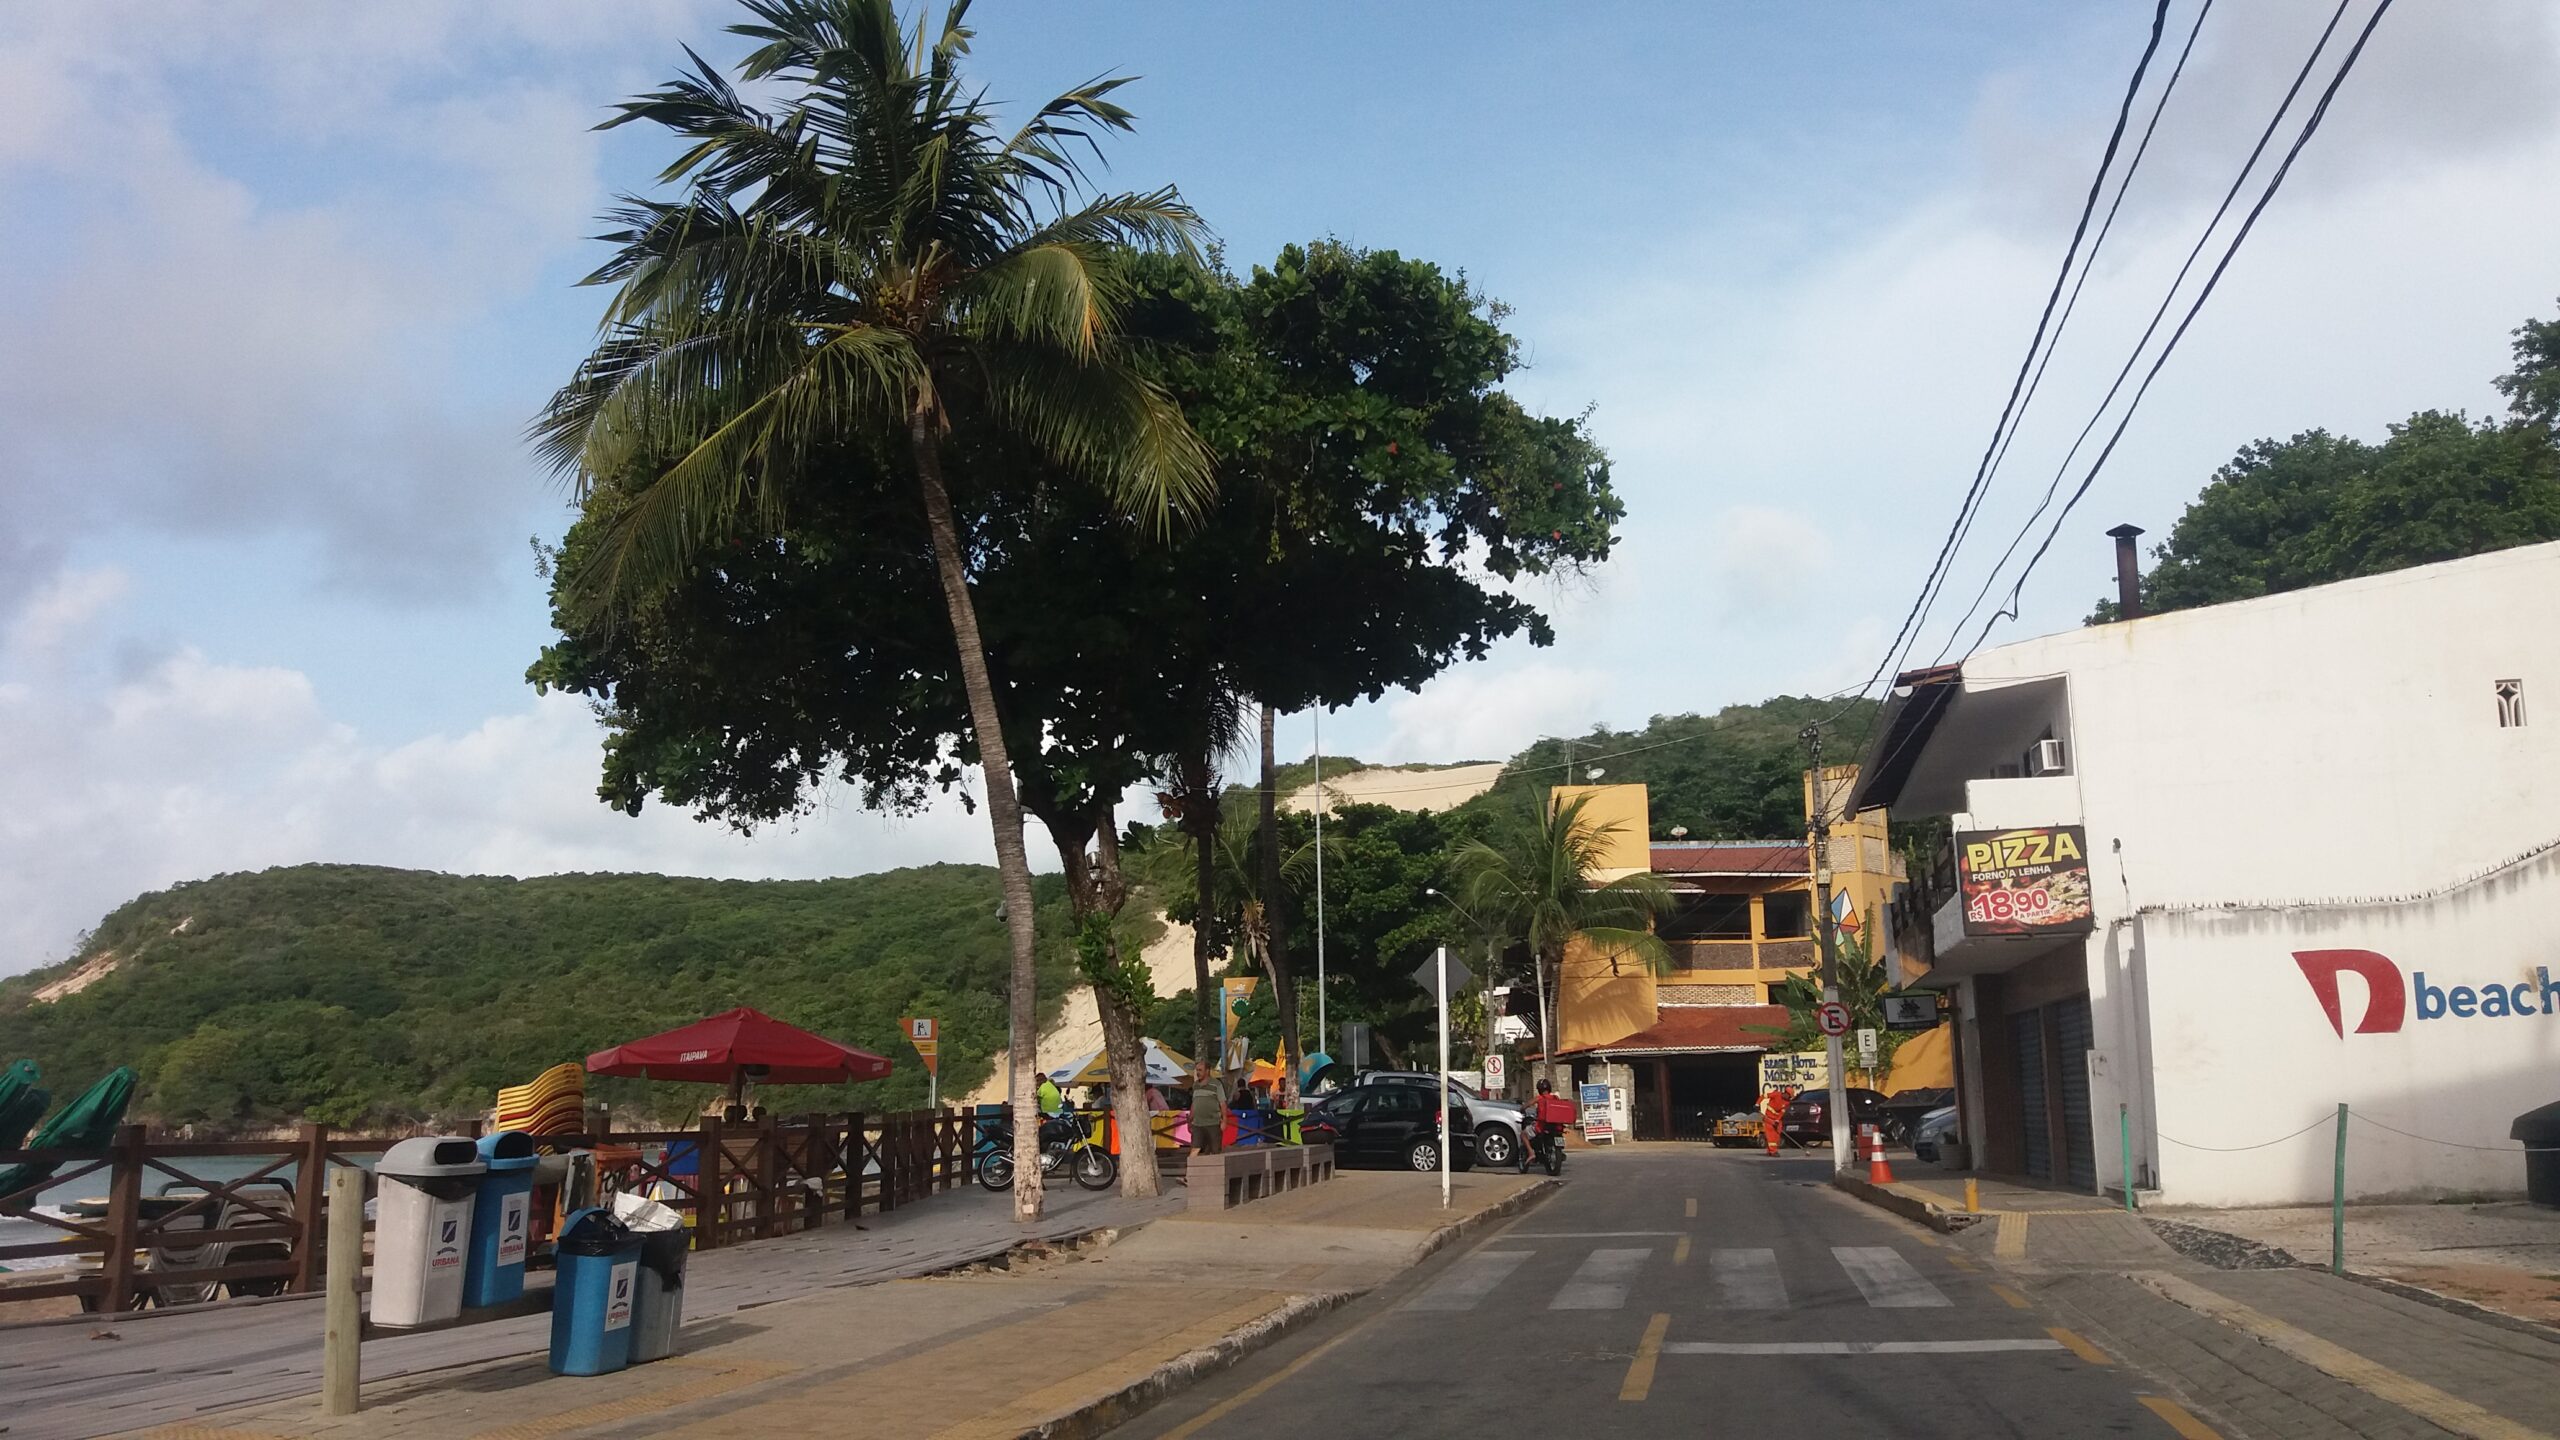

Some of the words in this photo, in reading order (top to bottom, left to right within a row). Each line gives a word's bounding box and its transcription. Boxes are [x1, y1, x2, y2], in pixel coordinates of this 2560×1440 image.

[1967, 832, 2081, 872] PIZZA
[1972, 870, 2006, 882] FORNO
[2008, 869, 2017, 878] A
[2018, 865, 2052, 876] LENHA
[2026, 909, 2051, 918] PARTIR
[2413, 966, 2560, 1020] beach
[1828, 1009, 1840, 1029] E
[1864, 1034, 1870, 1047] E
[680, 1050, 707, 1062] ITAIPAVA
[1803, 1072, 1815, 1080] do
[500, 1243, 525, 1254] URBANA
[432, 1256, 459, 1267] URBANA
